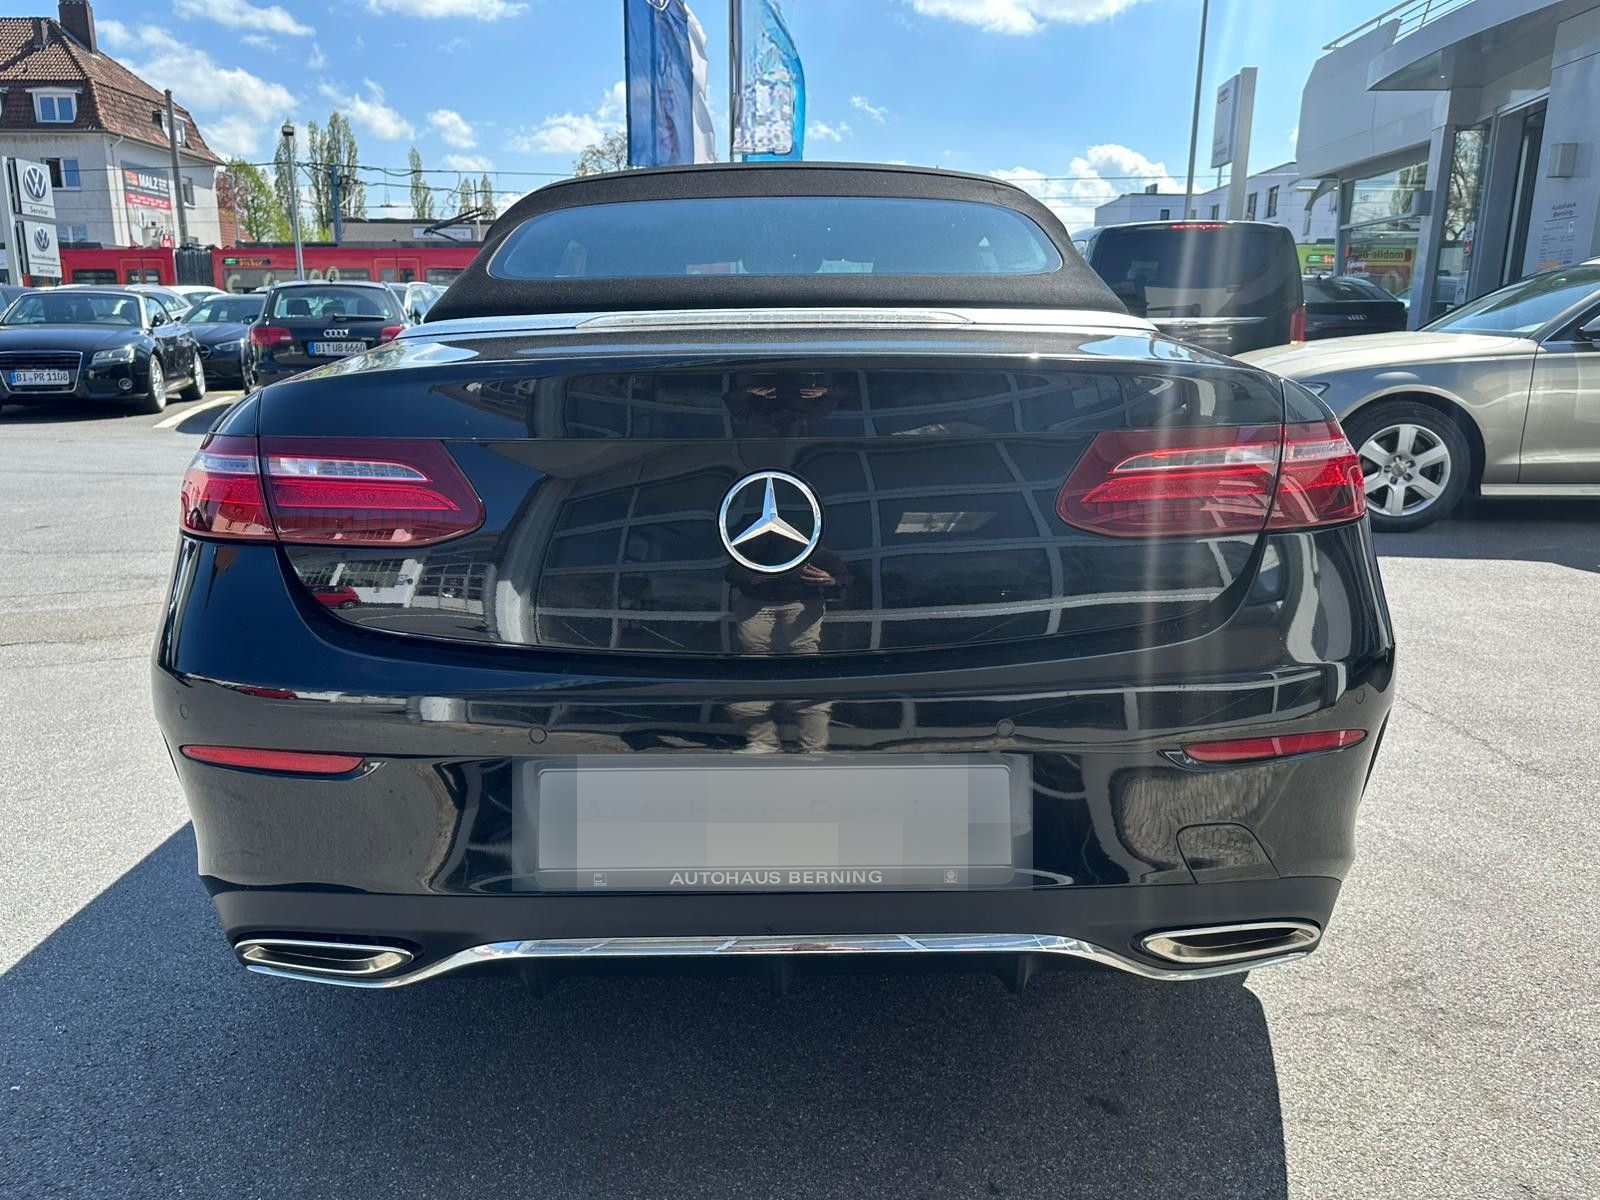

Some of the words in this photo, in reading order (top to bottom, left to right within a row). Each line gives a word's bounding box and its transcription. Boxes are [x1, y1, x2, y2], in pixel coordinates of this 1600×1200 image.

[29, 206, 49, 216] Service
[37, 266, 55, 275] Service
[669, 871, 782, 886] AUTOHAUS
[788, 870, 883, 885] BERNING
